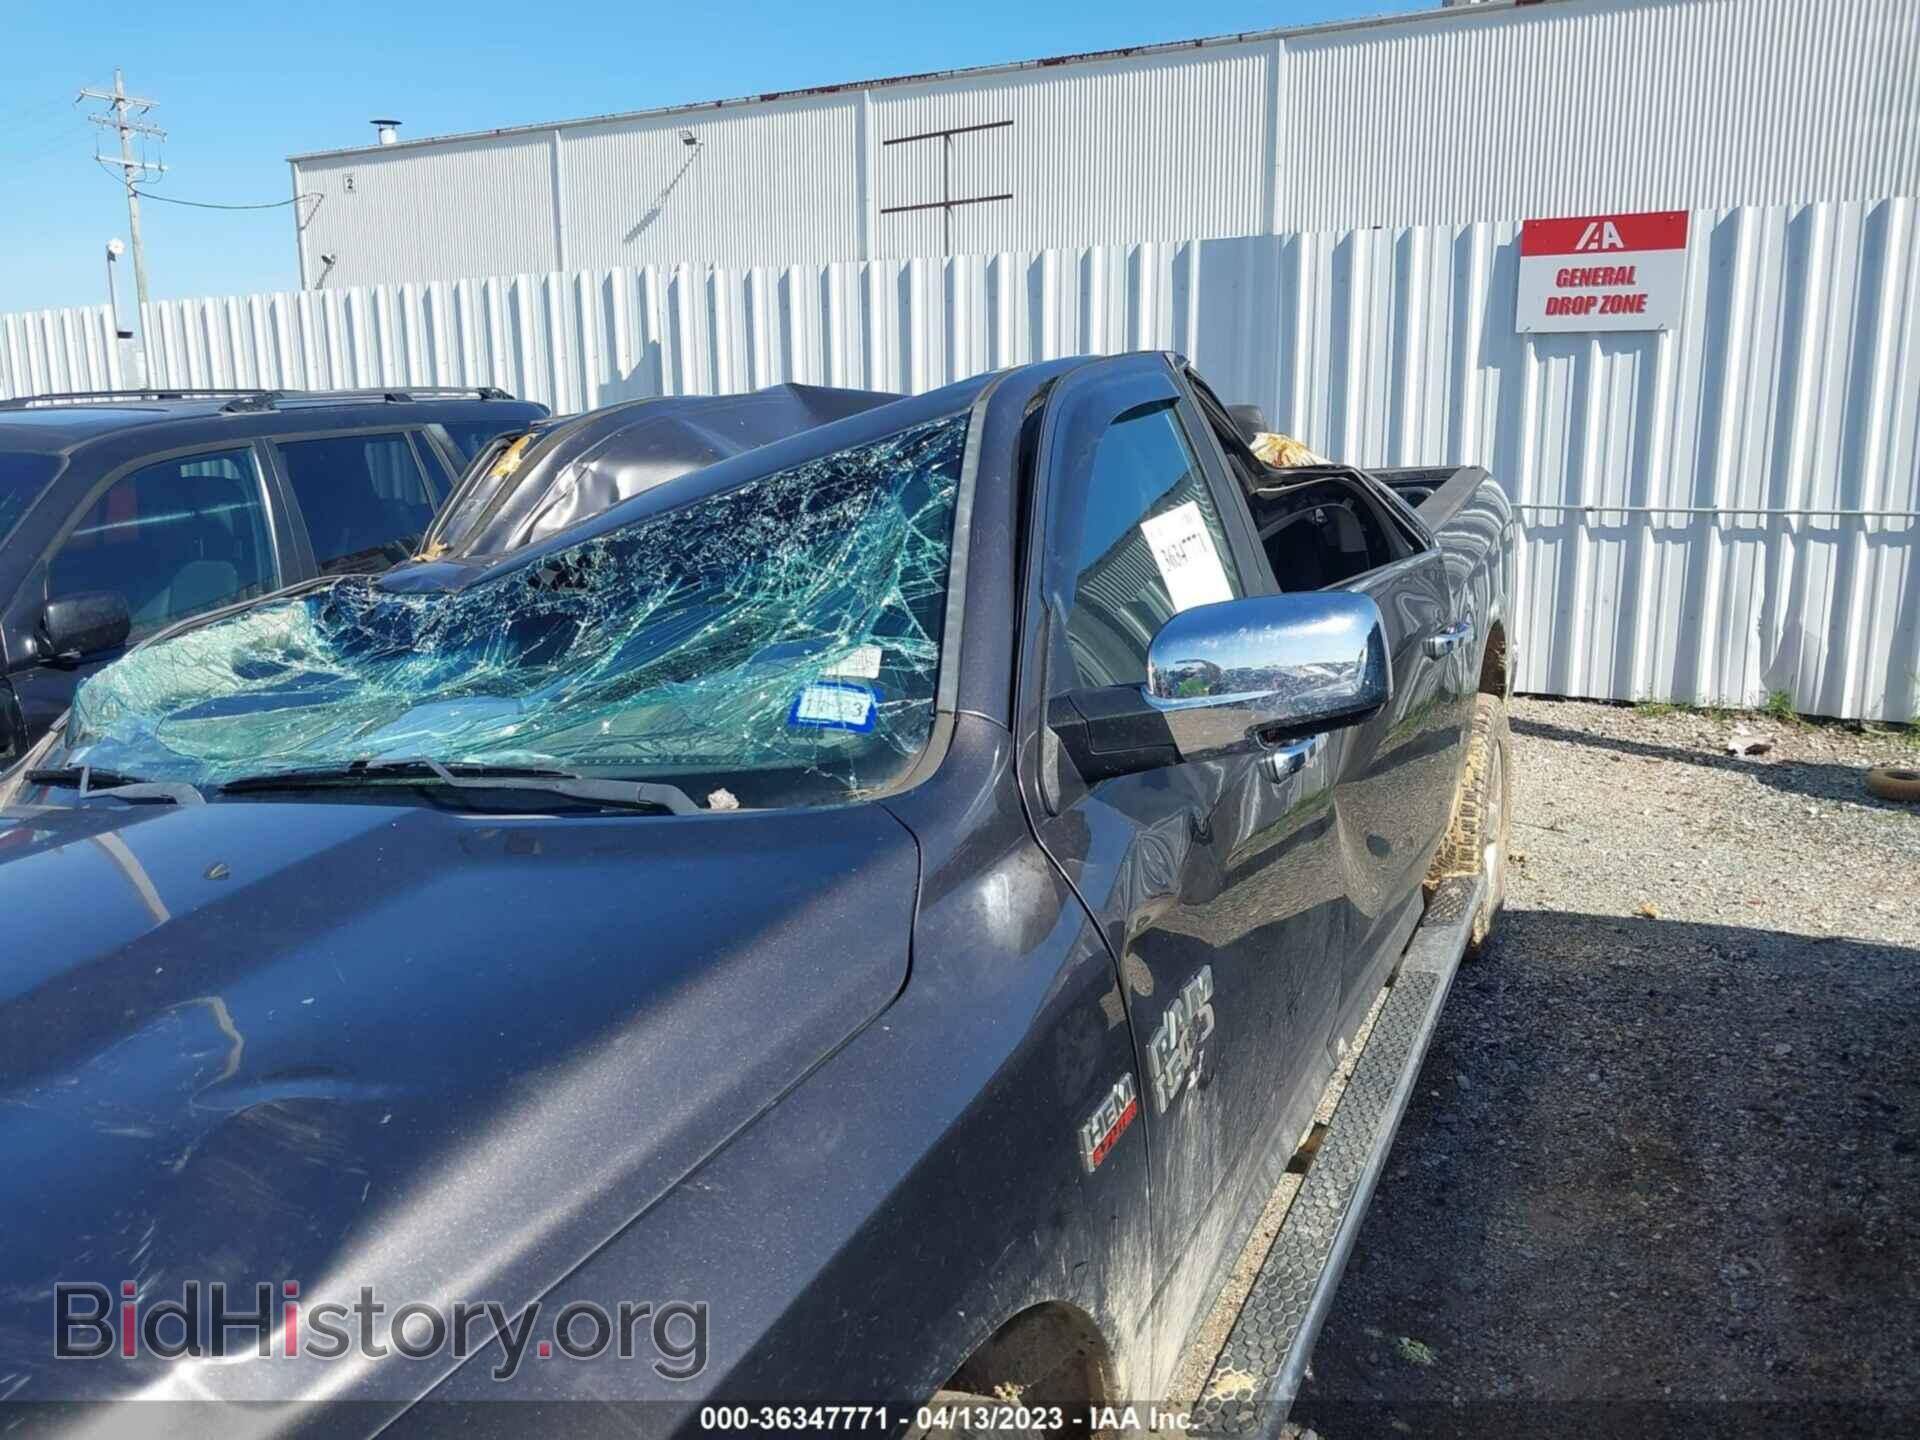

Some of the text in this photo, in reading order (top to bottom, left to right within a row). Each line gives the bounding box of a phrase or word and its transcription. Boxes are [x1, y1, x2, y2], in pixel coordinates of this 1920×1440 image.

[1555, 265, 1636, 288] GENERAL
[1545, 293, 1649, 316] DROP ZONE
